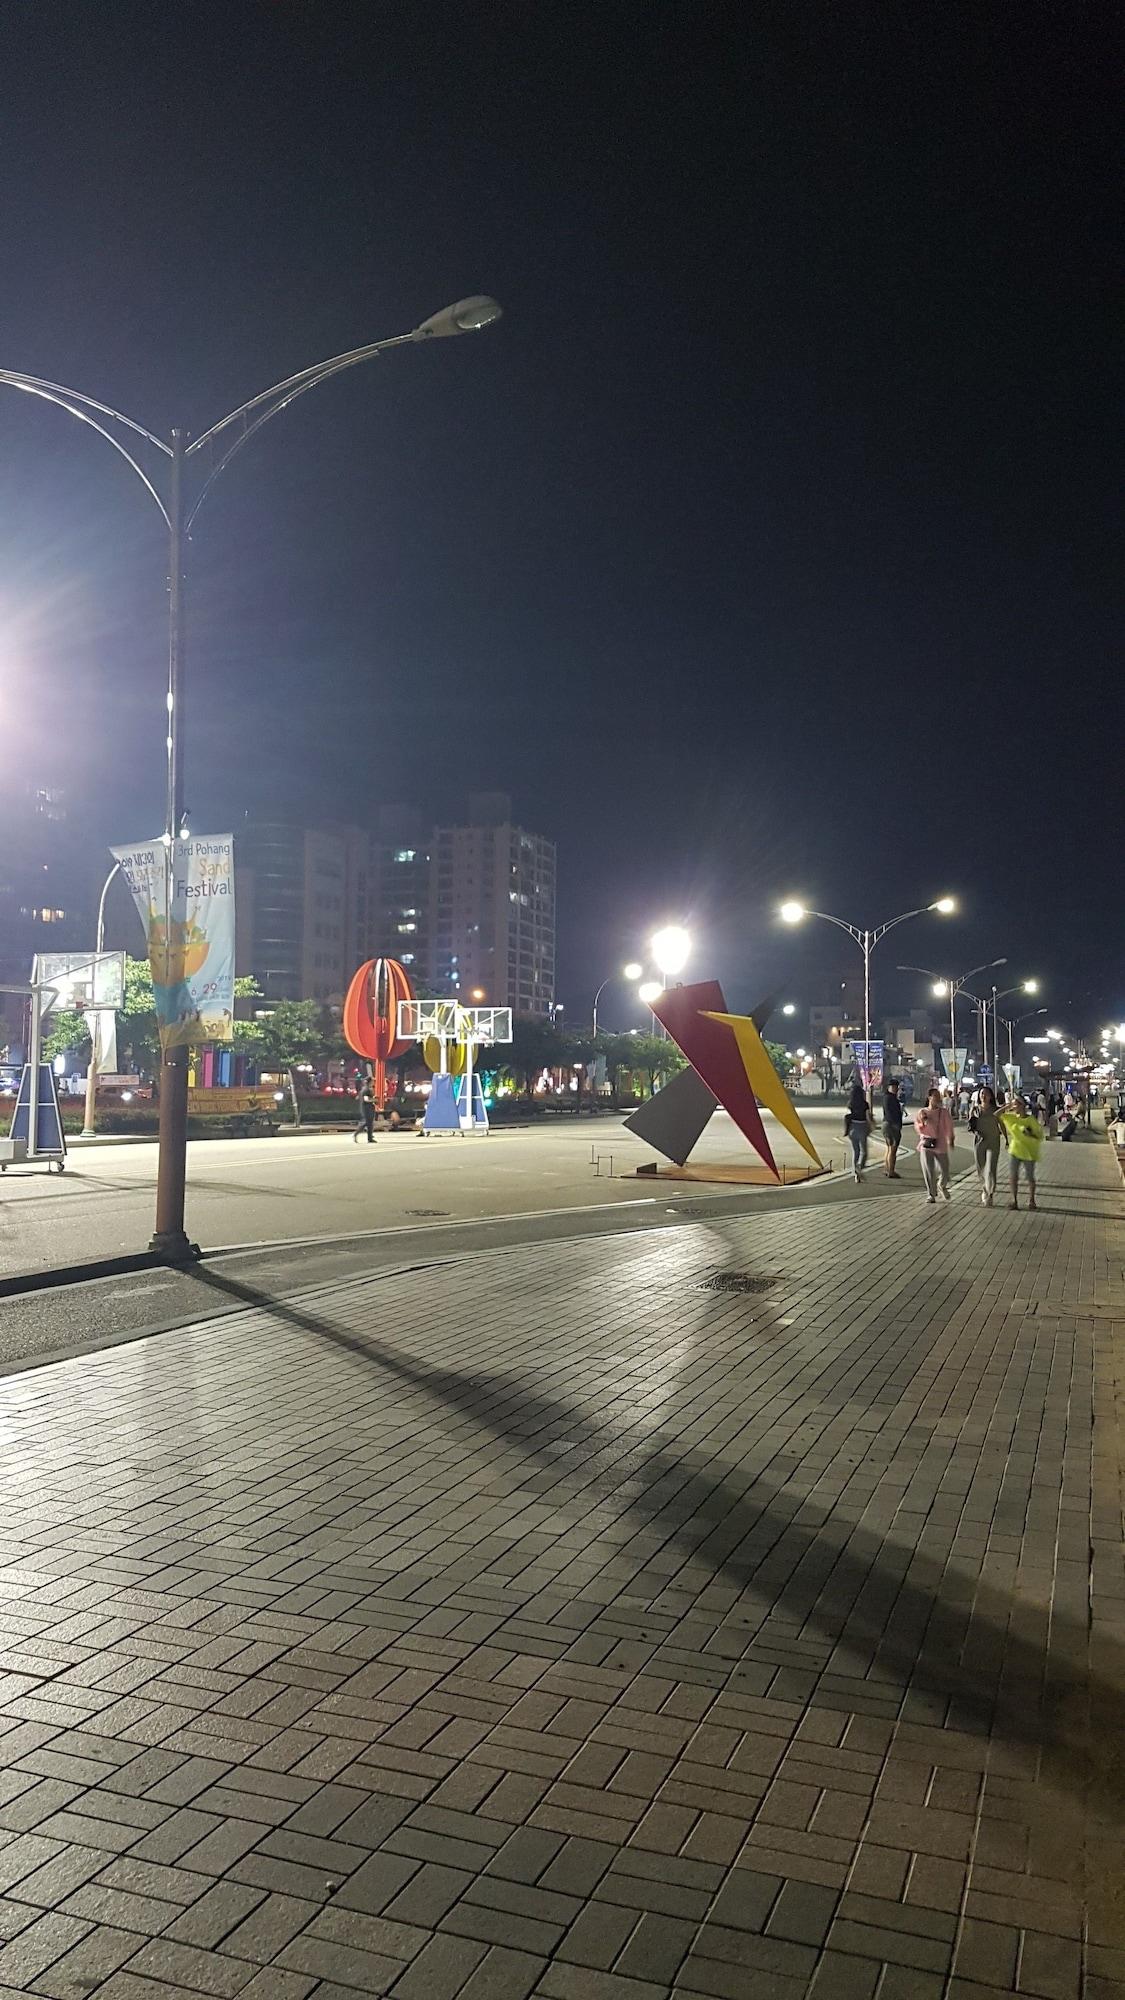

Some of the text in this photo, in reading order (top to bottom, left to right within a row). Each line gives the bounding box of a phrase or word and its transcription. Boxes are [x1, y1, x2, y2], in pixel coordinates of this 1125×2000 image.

[178, 842, 230, 856] 3rd Pohang
[200, 857, 230, 876] Sand
[176, 877, 232, 898] Festival
[202, 983, 218, 994] 29
